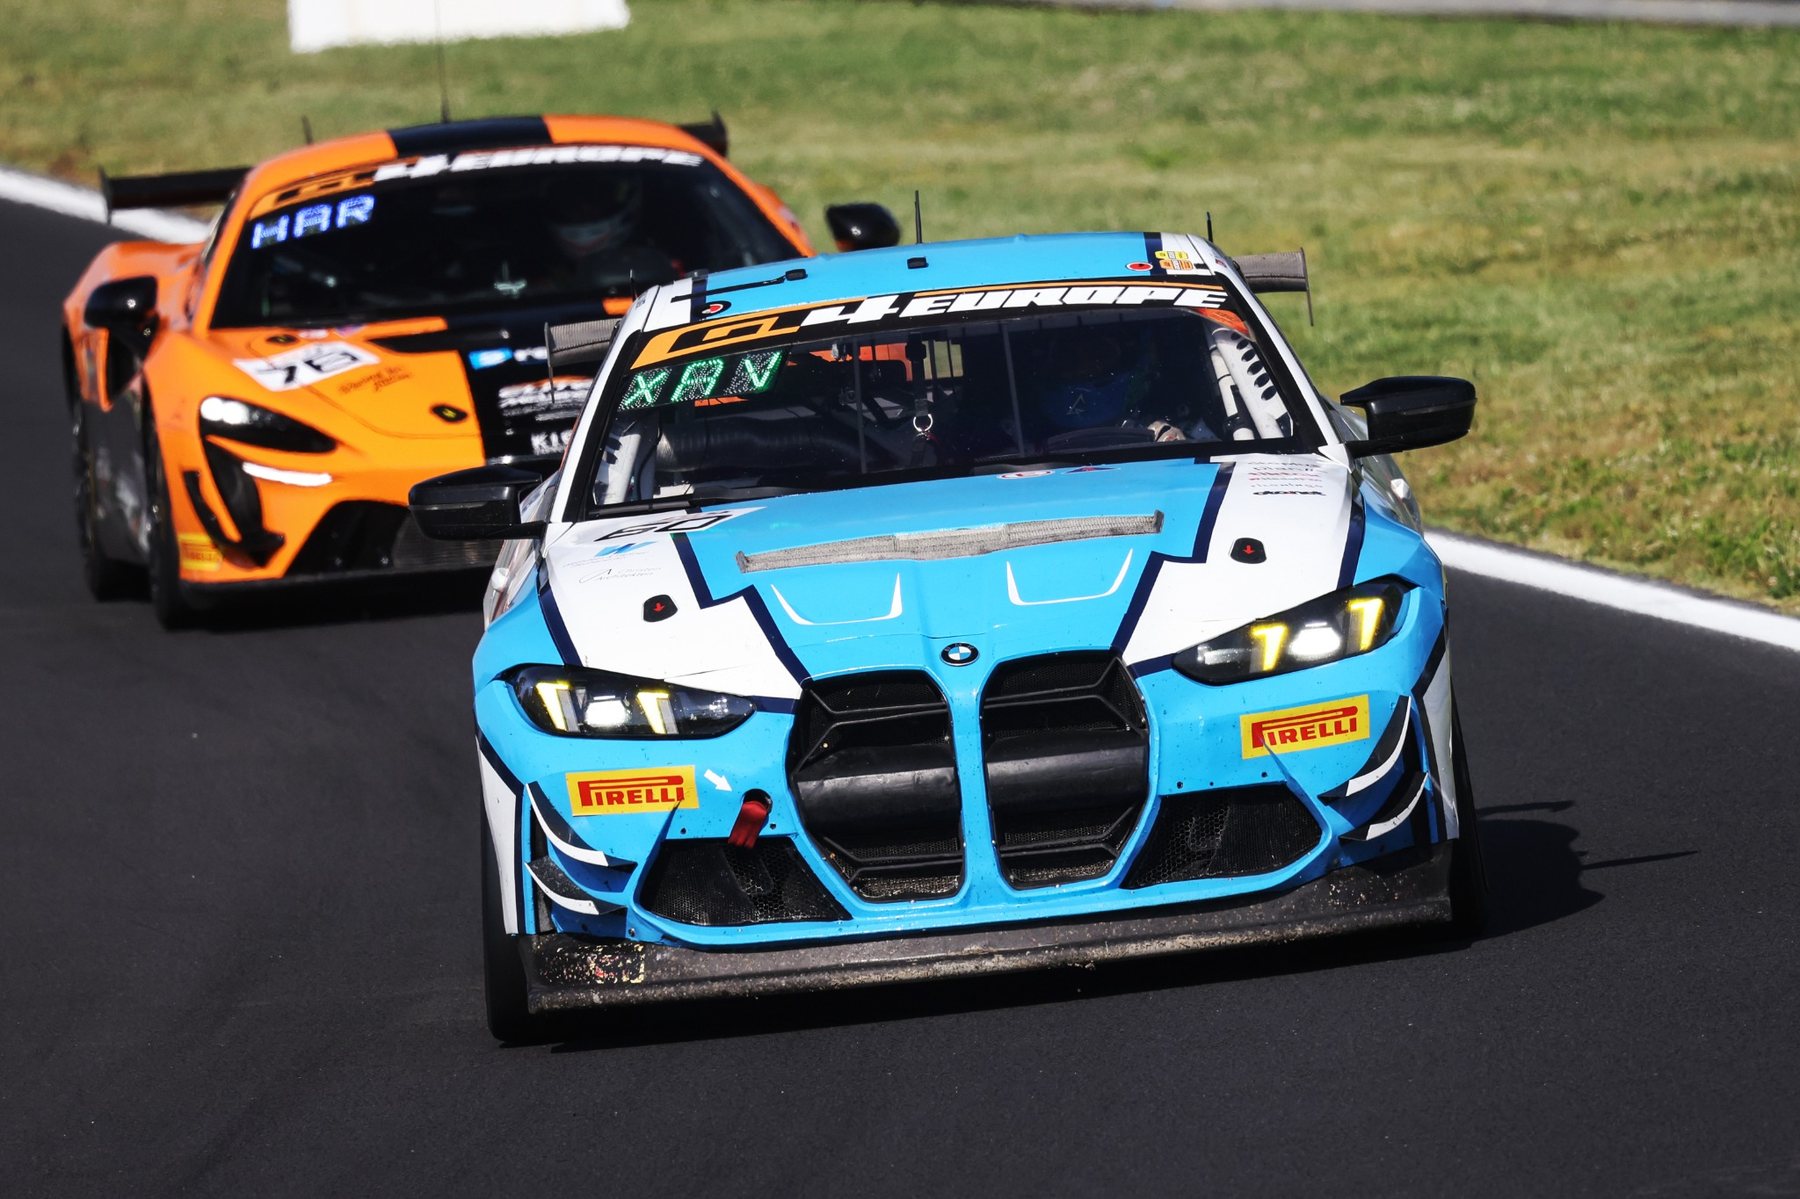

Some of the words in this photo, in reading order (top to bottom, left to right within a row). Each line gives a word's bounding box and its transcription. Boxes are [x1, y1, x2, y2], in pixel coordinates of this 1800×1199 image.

[251, 193, 376, 250] HAR
[898, 286, 1230, 319] EUROPE
[618, 351, 785, 411] XAV
[1251, 705, 1361, 753] PIRELLI
[577, 774, 687, 808] PIRELLI
